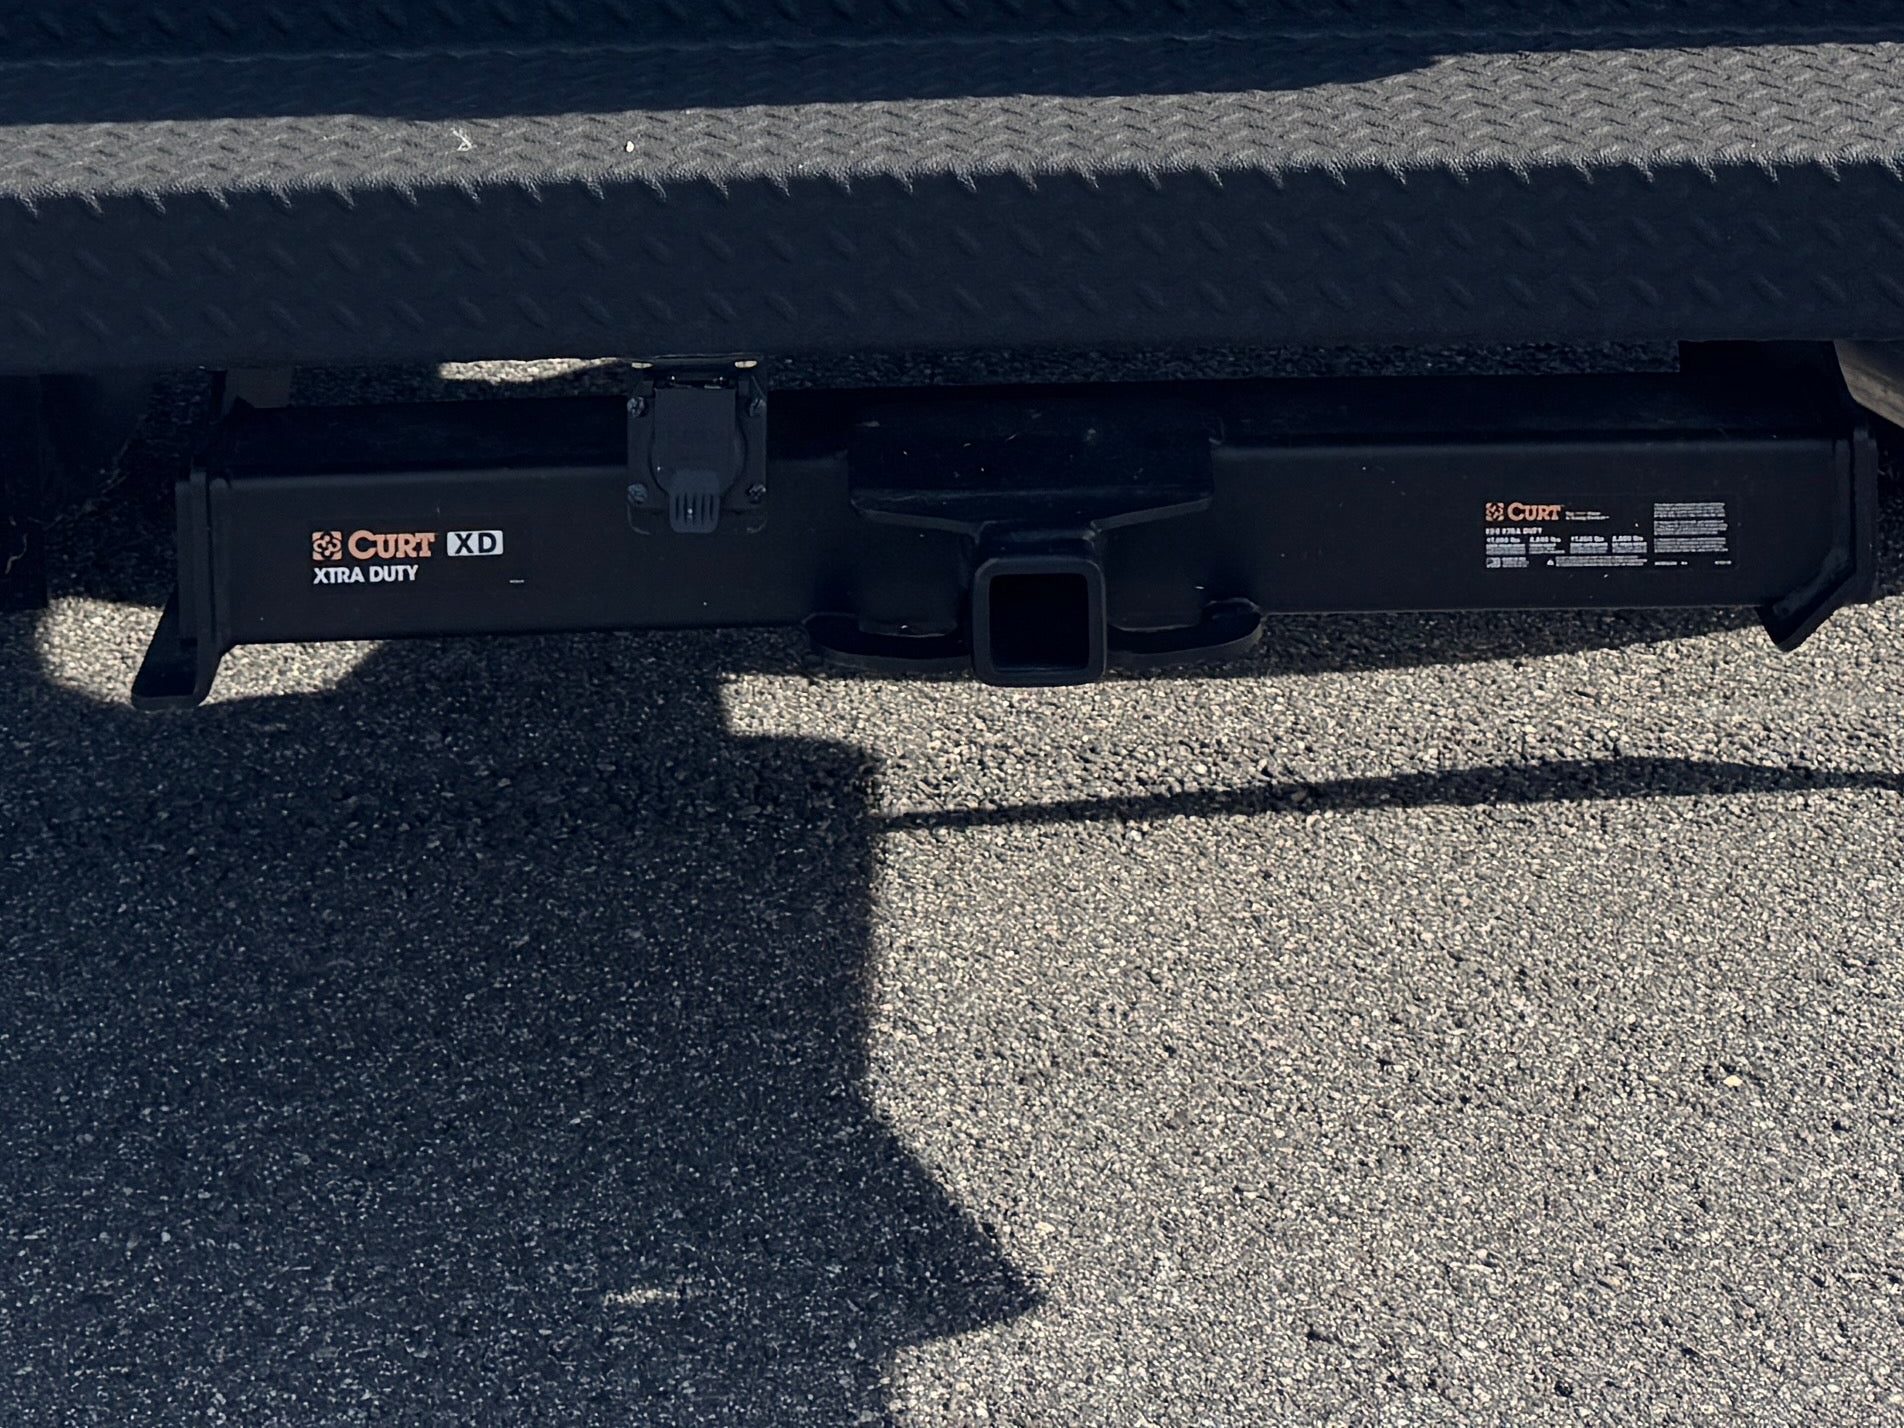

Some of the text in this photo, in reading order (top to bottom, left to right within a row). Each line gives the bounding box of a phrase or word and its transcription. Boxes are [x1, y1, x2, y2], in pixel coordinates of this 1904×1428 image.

[348, 530, 497, 560] CURT XD
[313, 565, 419, 584] XTRA DUTY
